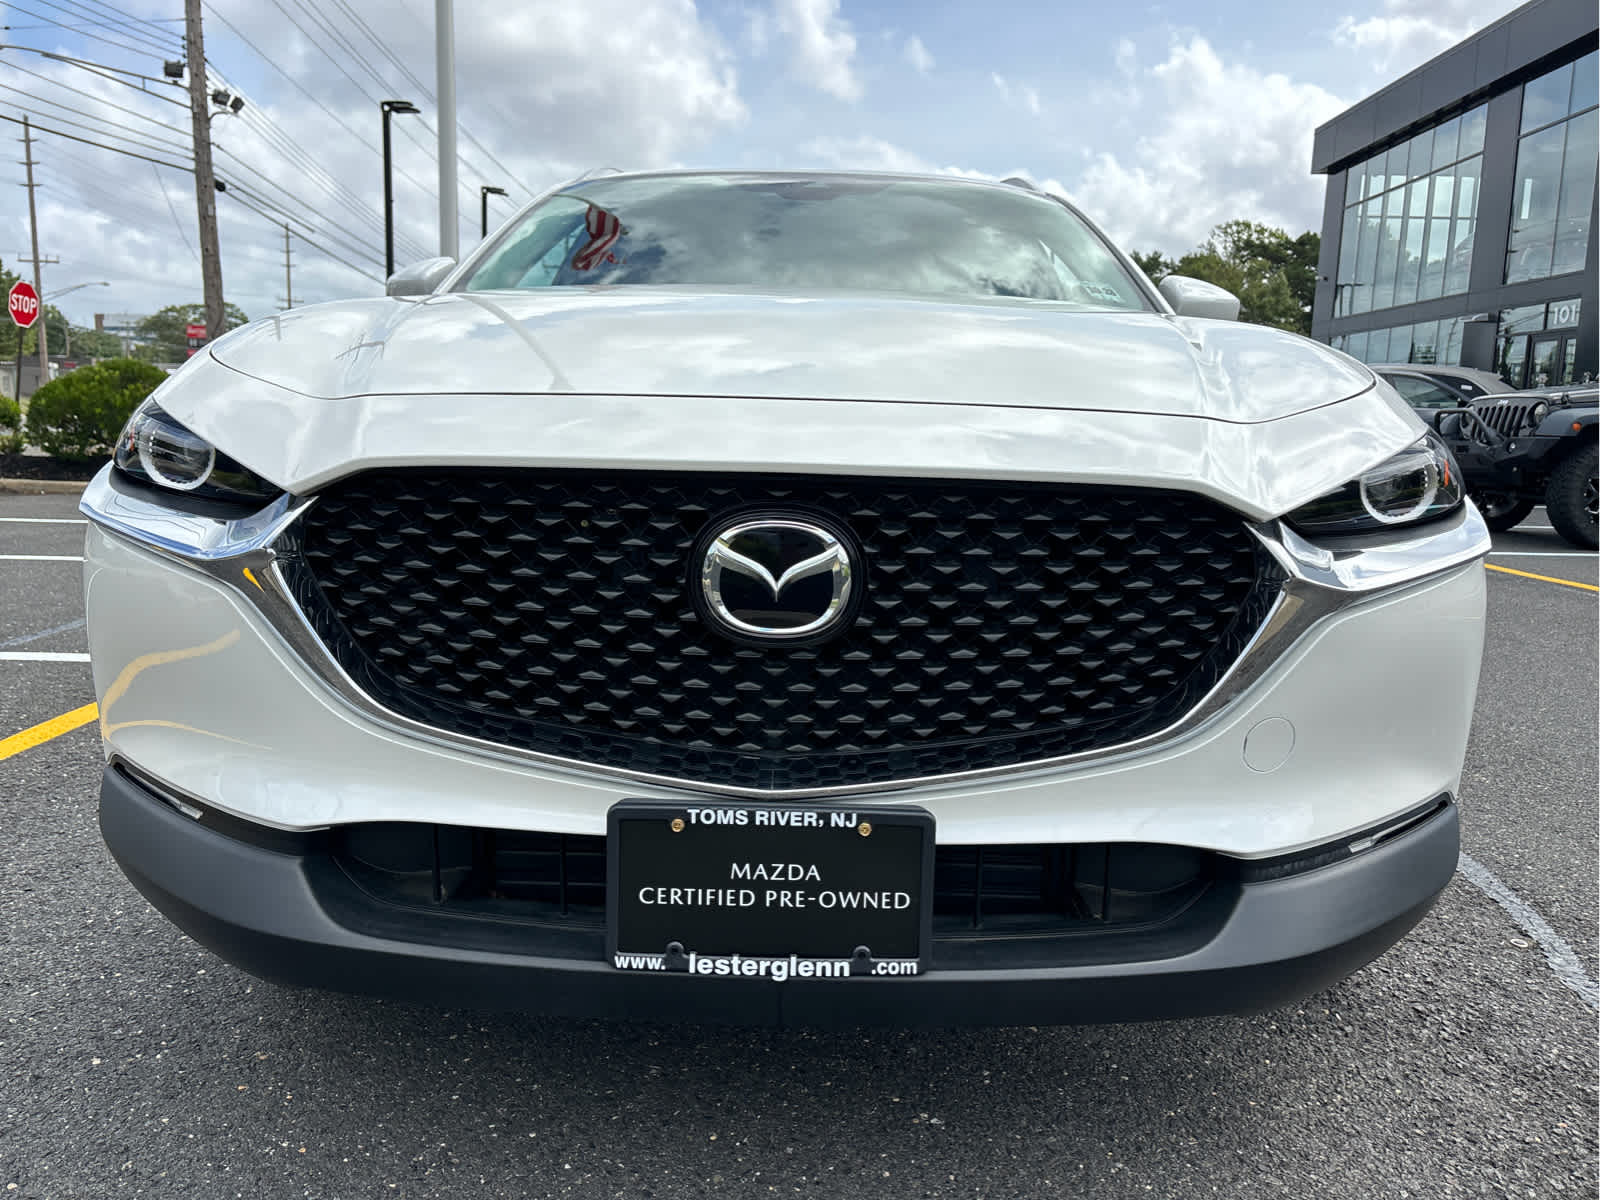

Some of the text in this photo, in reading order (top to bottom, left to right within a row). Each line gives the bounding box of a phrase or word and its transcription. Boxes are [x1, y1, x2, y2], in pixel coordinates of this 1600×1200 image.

[11, 293, 37, 314] STOP
[1553, 304, 1577, 325] 101
[687, 809, 858, 828] TOMS RIVER, NJ
[730, 863, 822, 882] MAZDA
[638, 887, 911, 910] CERTIFIED PRE-OWNED
[614, 952, 918, 982] www. lesterglenn .com
